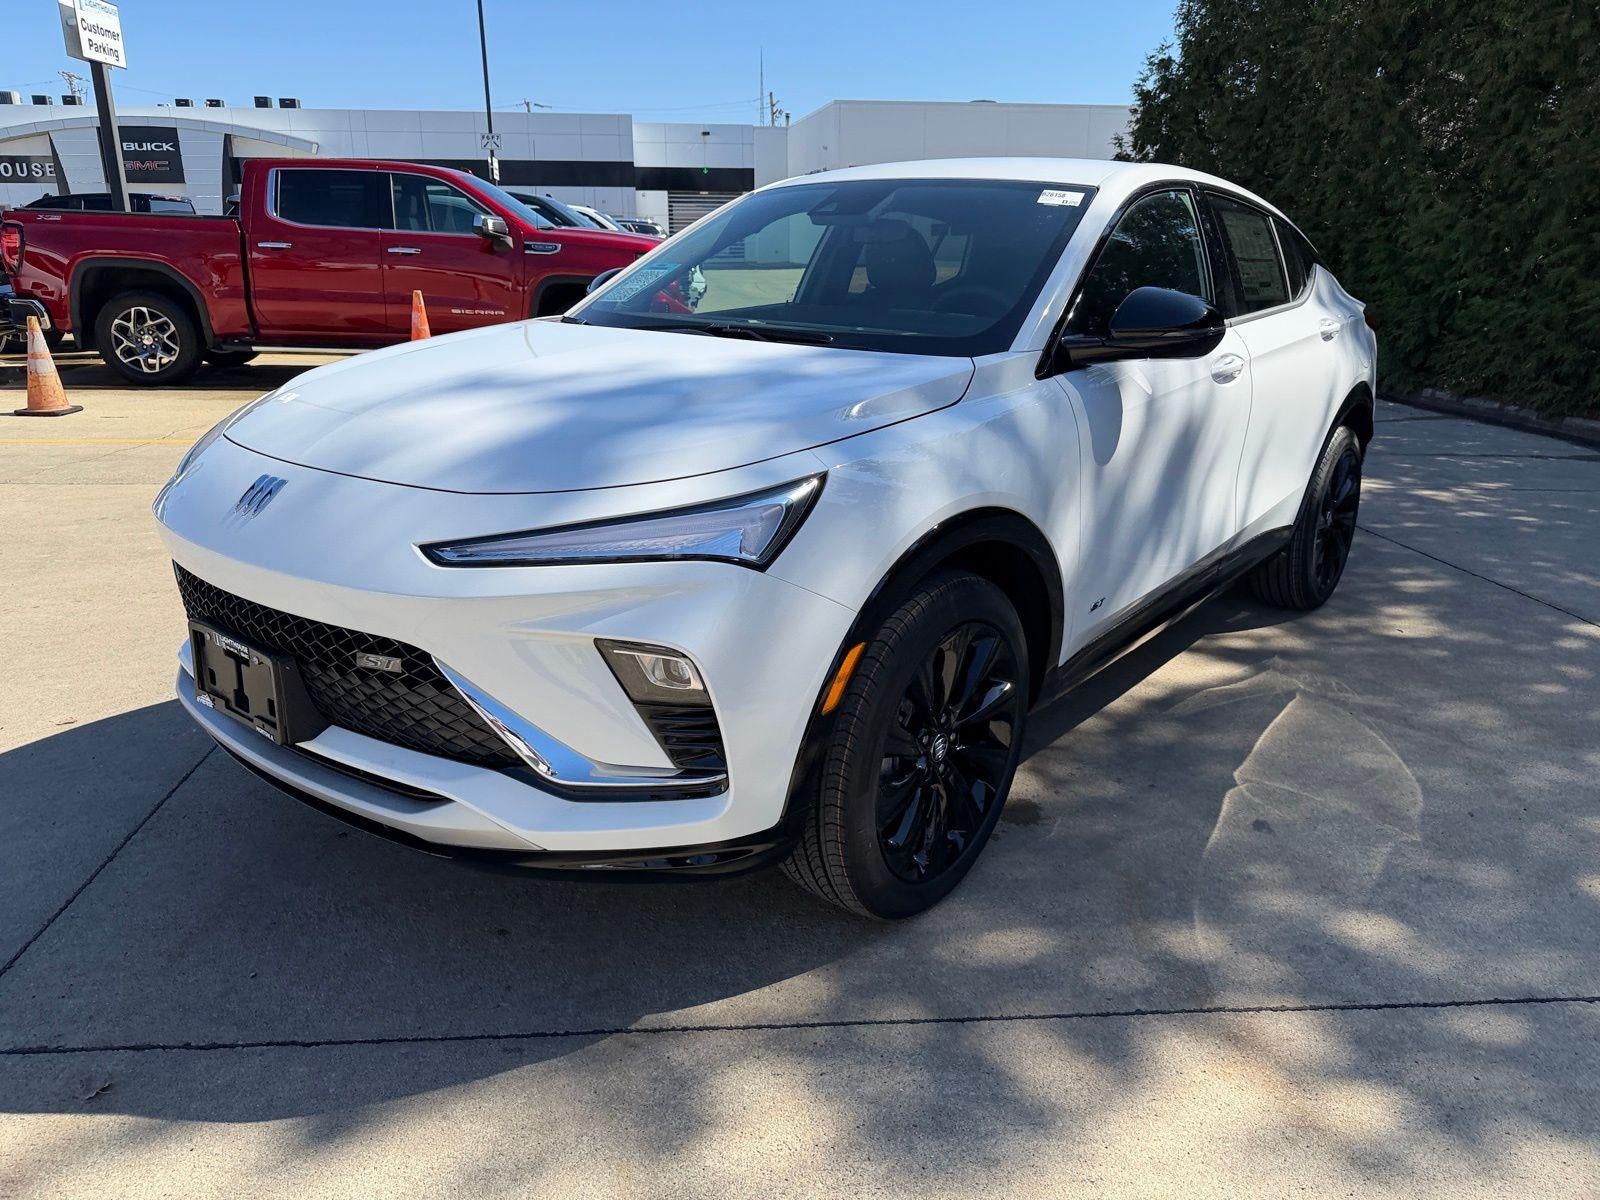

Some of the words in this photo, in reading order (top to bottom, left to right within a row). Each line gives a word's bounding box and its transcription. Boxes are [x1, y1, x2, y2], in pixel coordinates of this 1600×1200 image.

[80, 17, 120, 41] Customer
[87, 37, 120, 61] Parking
[122, 142, 176, 151] BUICK
[124, 160, 170, 171] GMC
[451, 308, 505, 316] SIERRA
[357, 653, 401, 673] ST
